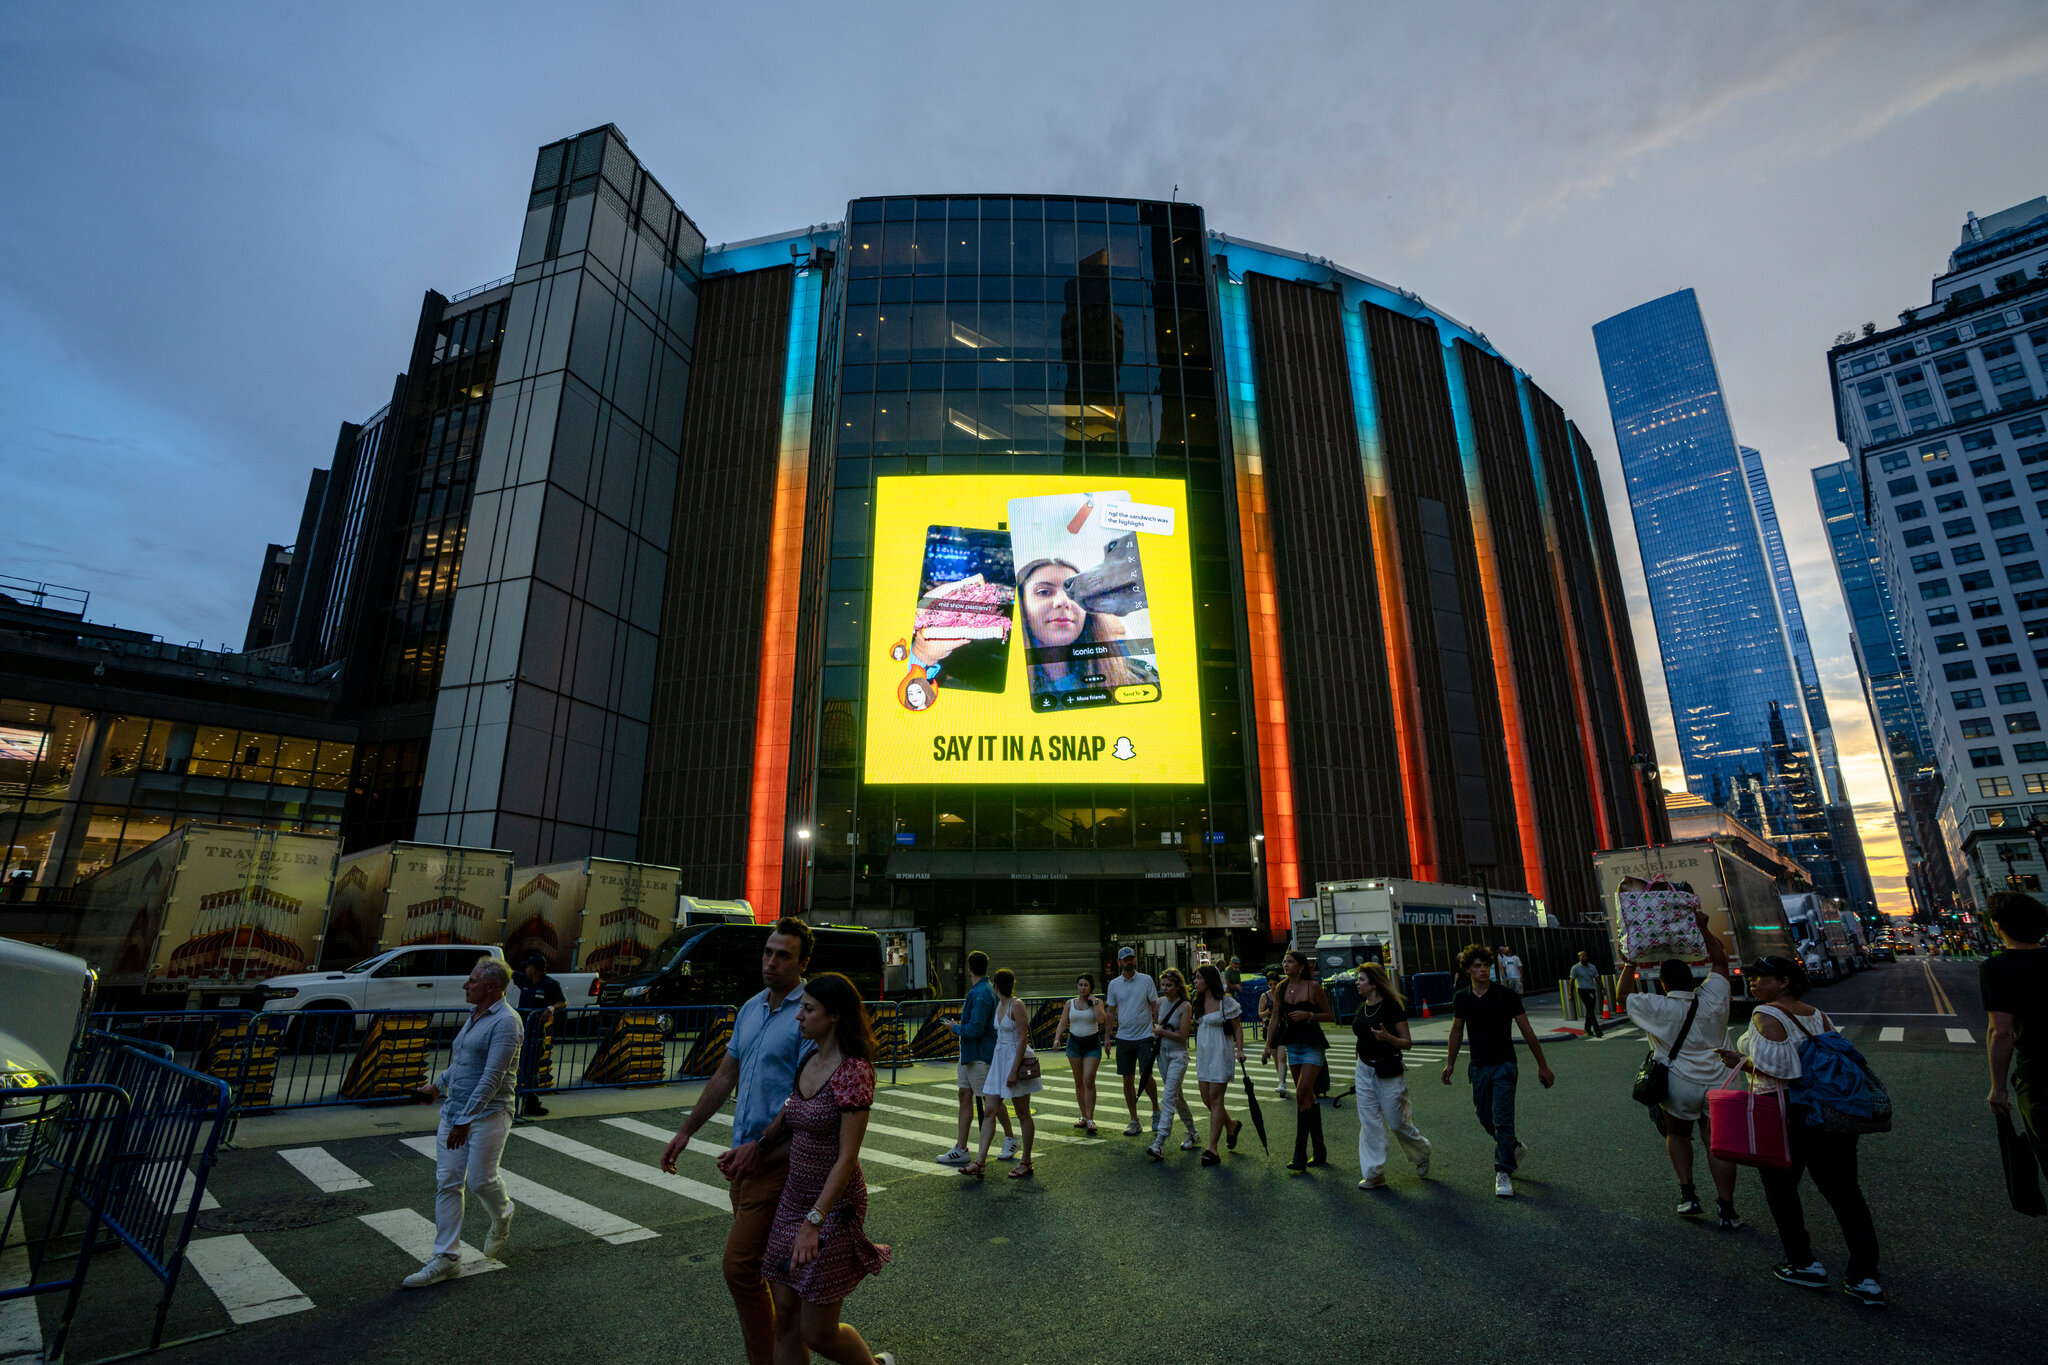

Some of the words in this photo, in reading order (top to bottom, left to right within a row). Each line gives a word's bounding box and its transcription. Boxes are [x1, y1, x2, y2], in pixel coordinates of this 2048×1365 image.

[1119, 518, 1144, 527] highlight
[1130, 514, 1156, 522] sandwich
[965, 604, 992, 612] pastrami?
[1095, 646, 1108, 654] tbh
[933, 735, 973, 761] SAY
[977, 735, 997, 761] IT
[1002, 735, 1024, 761] IN
[1029, 735, 1044, 761] A
[1048, 735, 1105, 761] SNAP
[205, 846, 319, 865] TRAVELLER
[408, 862, 495, 877] TRAVELLER
[1611, 858, 1699, 874] TRAVELLER
[600, 875, 668, 891] TRAVELLER
[1405, 911, 1425, 925] TOP
[1427, 912, 1453, 925] RANK
